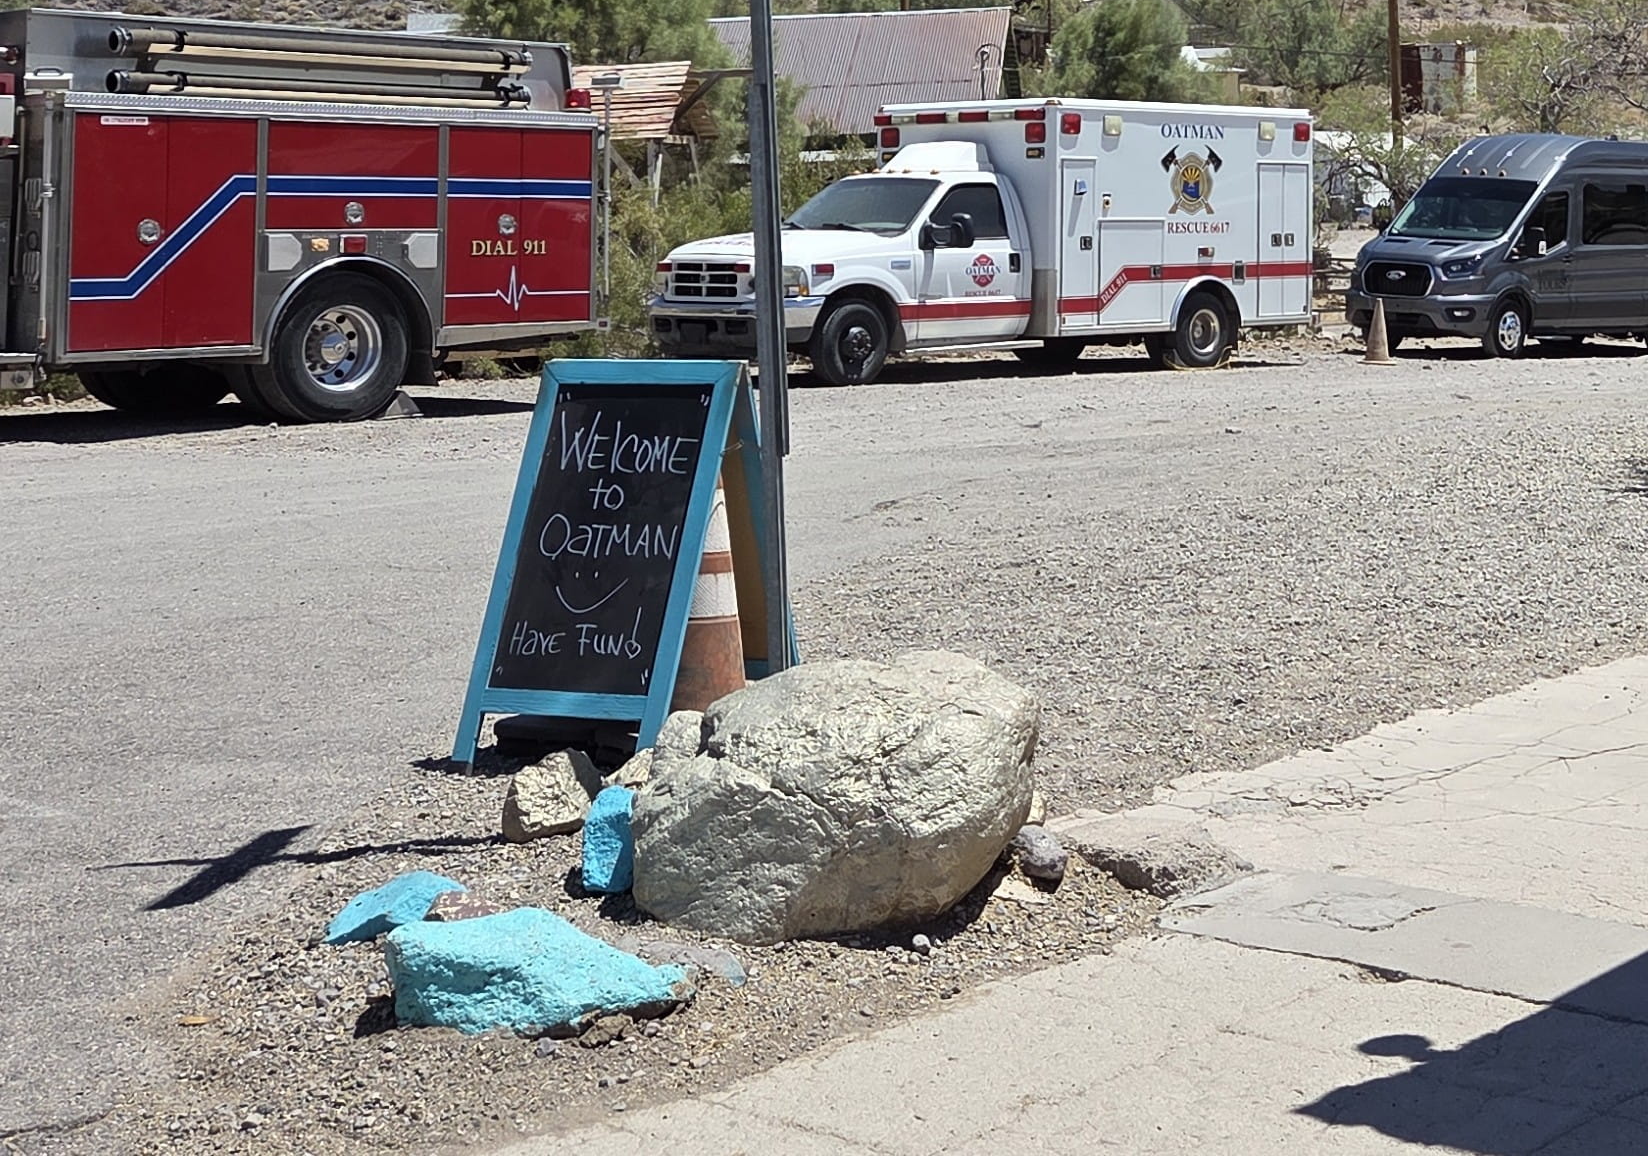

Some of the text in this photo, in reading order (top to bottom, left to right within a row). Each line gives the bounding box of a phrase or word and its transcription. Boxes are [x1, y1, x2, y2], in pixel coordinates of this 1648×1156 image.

[1160, 123, 1225, 140] OATMAN
[1167, 222, 1209, 234] RESCUE
[471, 239, 547, 256] DIAL 911
[589, 478, 625, 510] to
